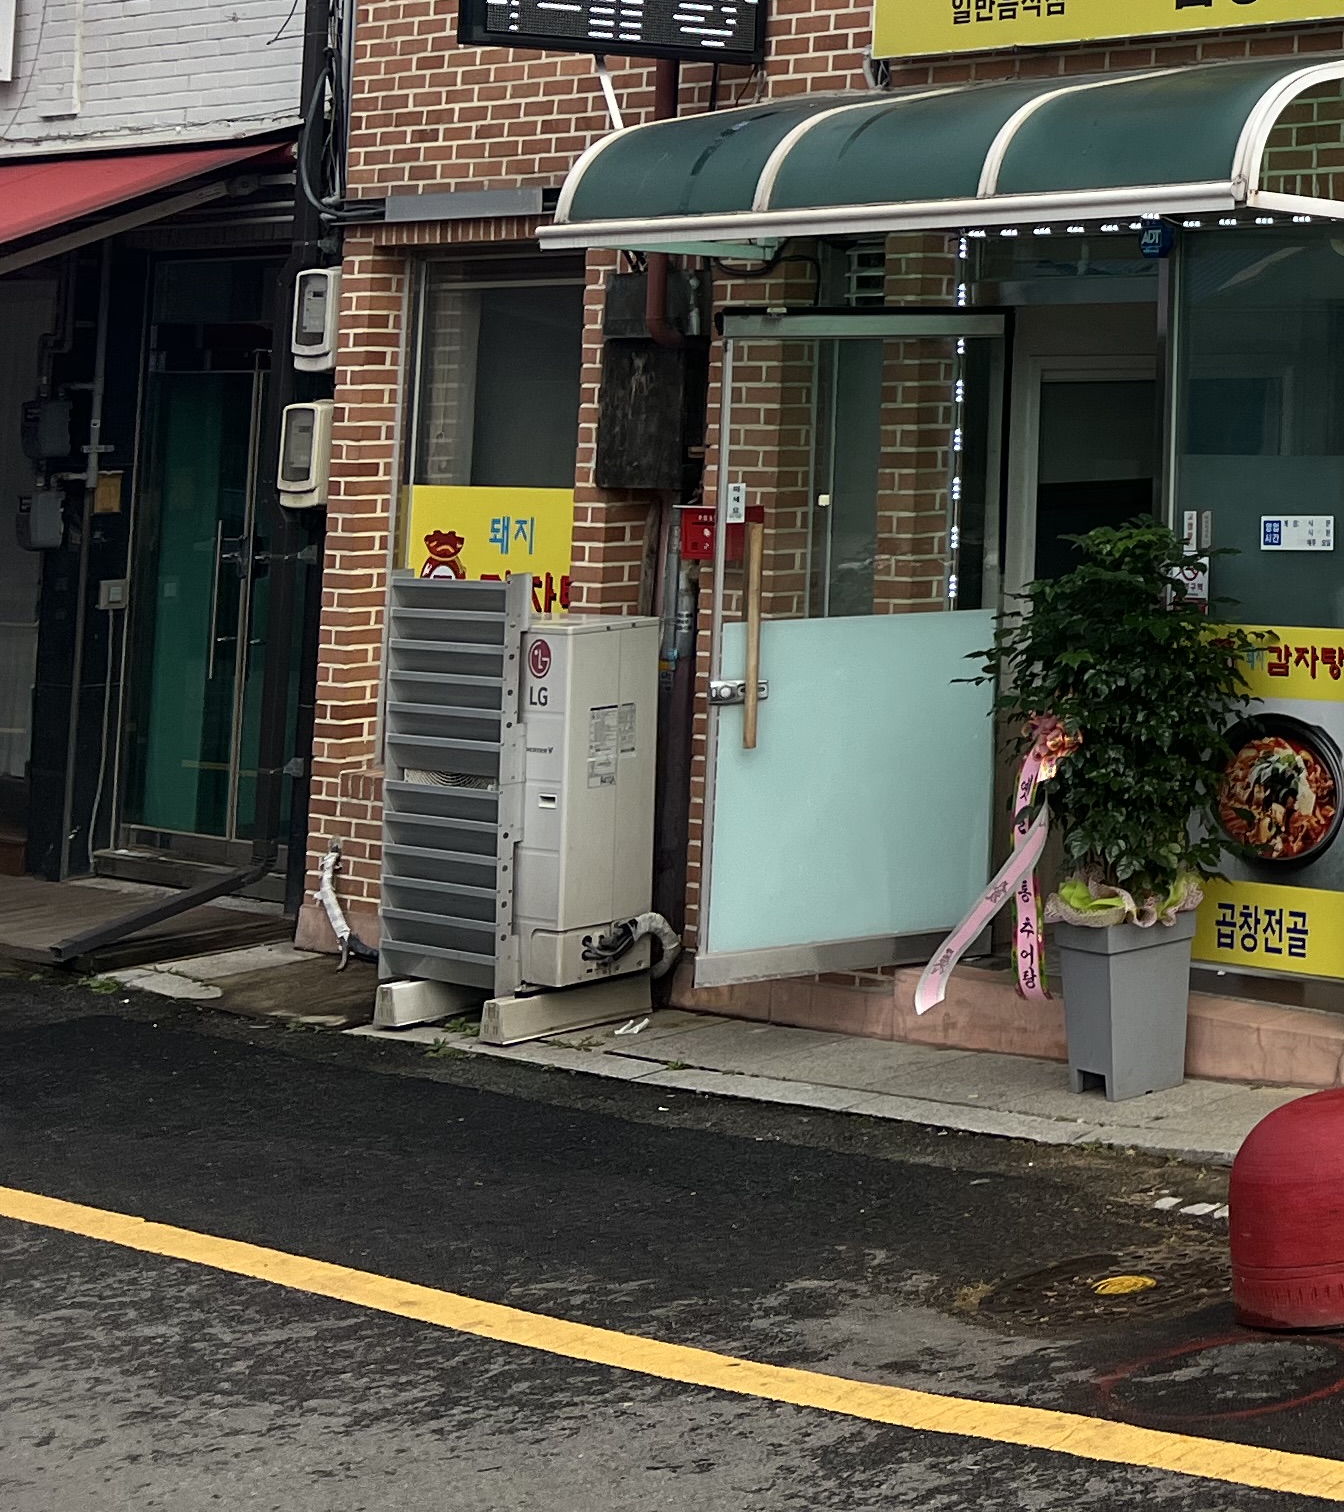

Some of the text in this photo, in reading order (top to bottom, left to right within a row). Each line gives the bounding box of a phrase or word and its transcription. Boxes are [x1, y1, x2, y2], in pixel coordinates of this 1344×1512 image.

[1141, 229, 1162, 245] ADT
[489, 515, 535, 556] 돼지
[529, 686, 549, 707] LG
[1215, 902, 1309, 959] 곱창전골
